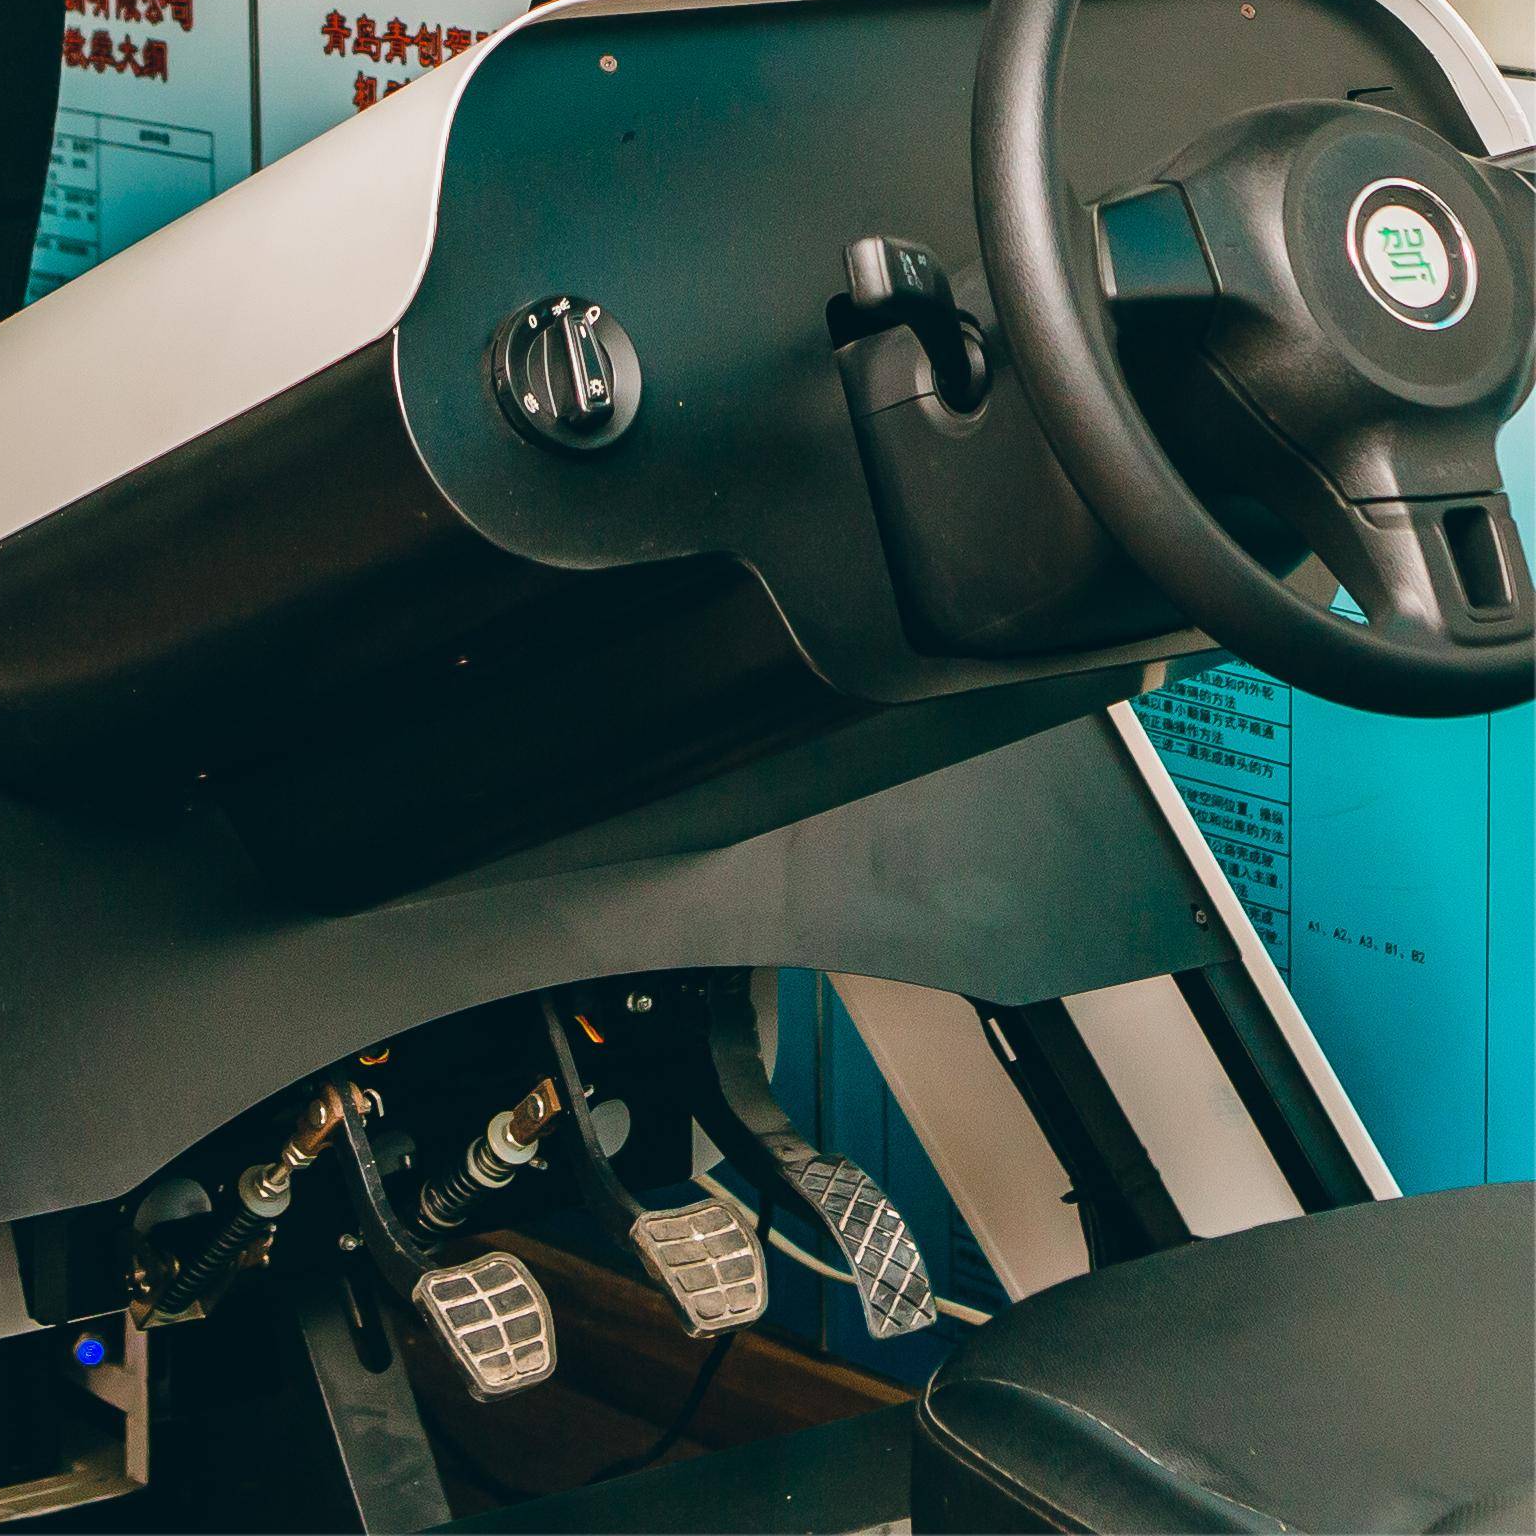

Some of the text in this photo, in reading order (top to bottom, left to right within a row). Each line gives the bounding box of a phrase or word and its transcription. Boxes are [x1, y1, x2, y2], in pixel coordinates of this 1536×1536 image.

[321, 8, 497, 69] 青岛青创驾
